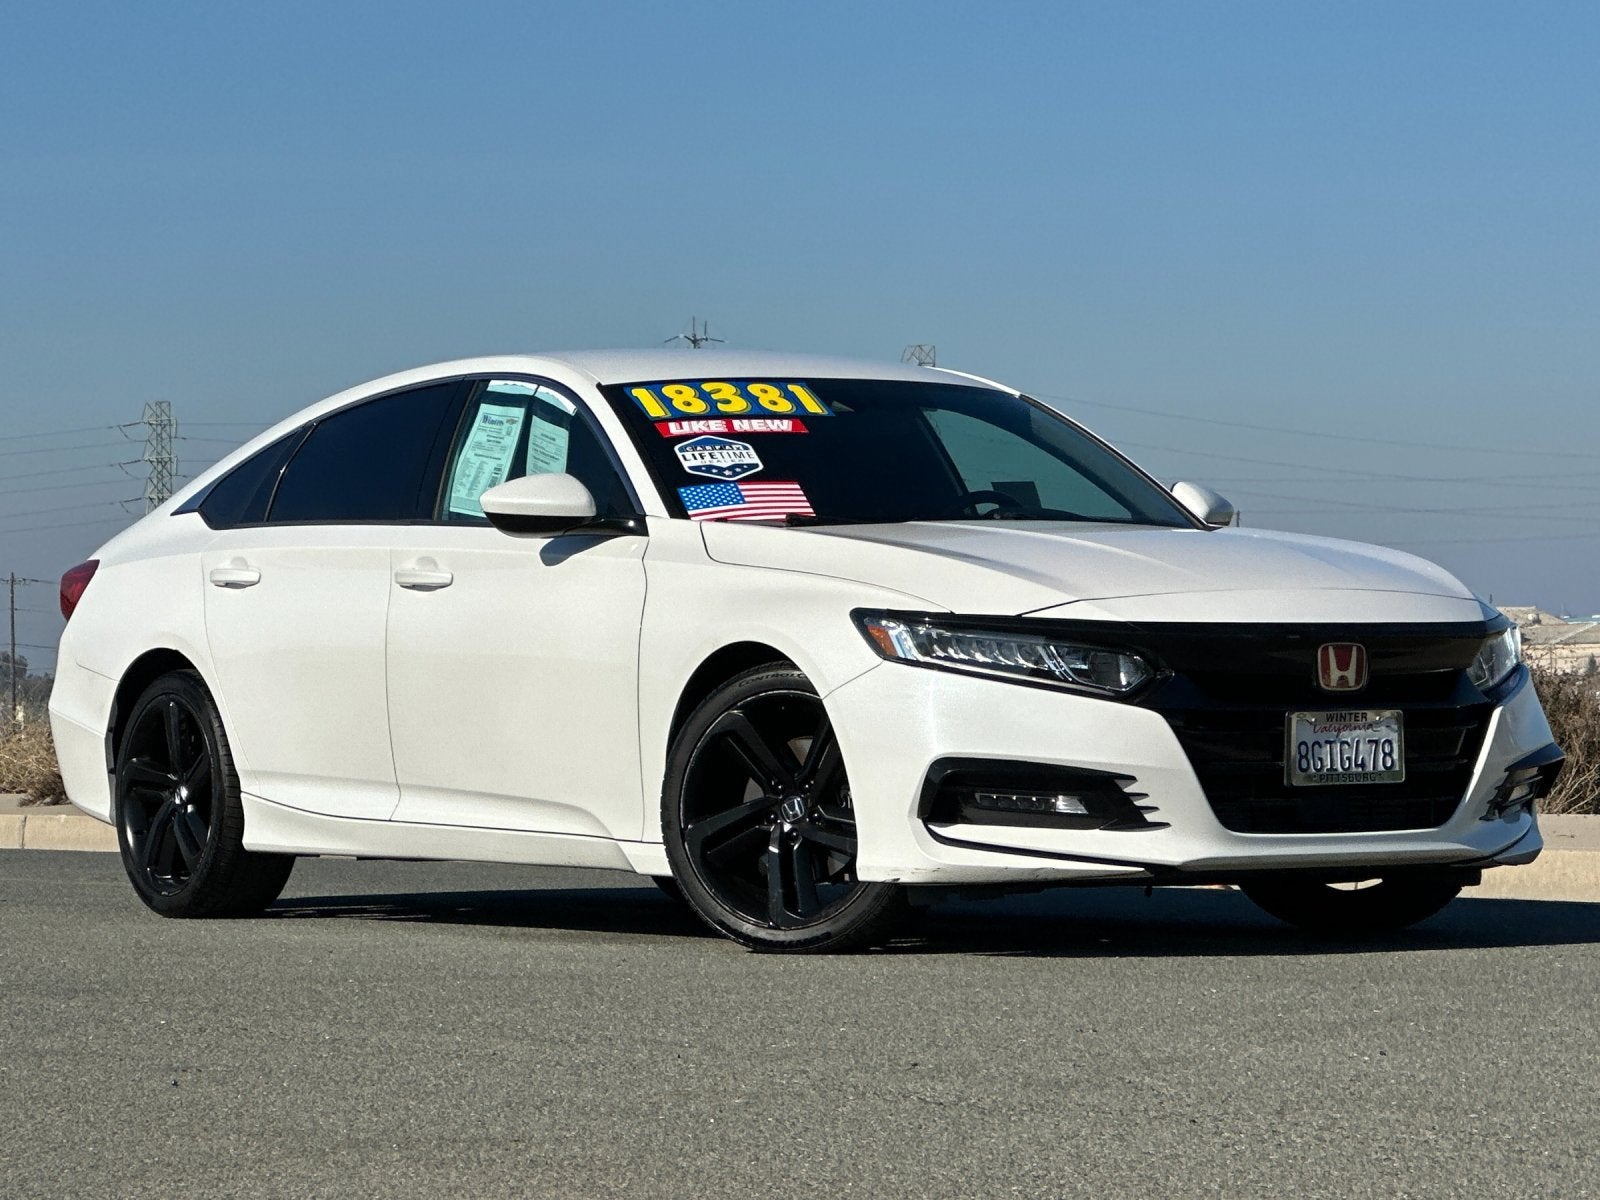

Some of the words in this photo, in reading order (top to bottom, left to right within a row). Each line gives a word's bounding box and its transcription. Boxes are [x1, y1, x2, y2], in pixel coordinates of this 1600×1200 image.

[631, 382, 829, 418] 18381
[668, 420, 728, 435] LIKE
[732, 419, 793, 433] NEW
[685, 444, 744, 452] CARFAX
[681, 451, 755, 462] LIFETIME
[1325, 711, 1368, 722] WINTER
[1297, 738, 1395, 773] 8GIG478
[1320, 772, 1377, 783] PITTSBURG
